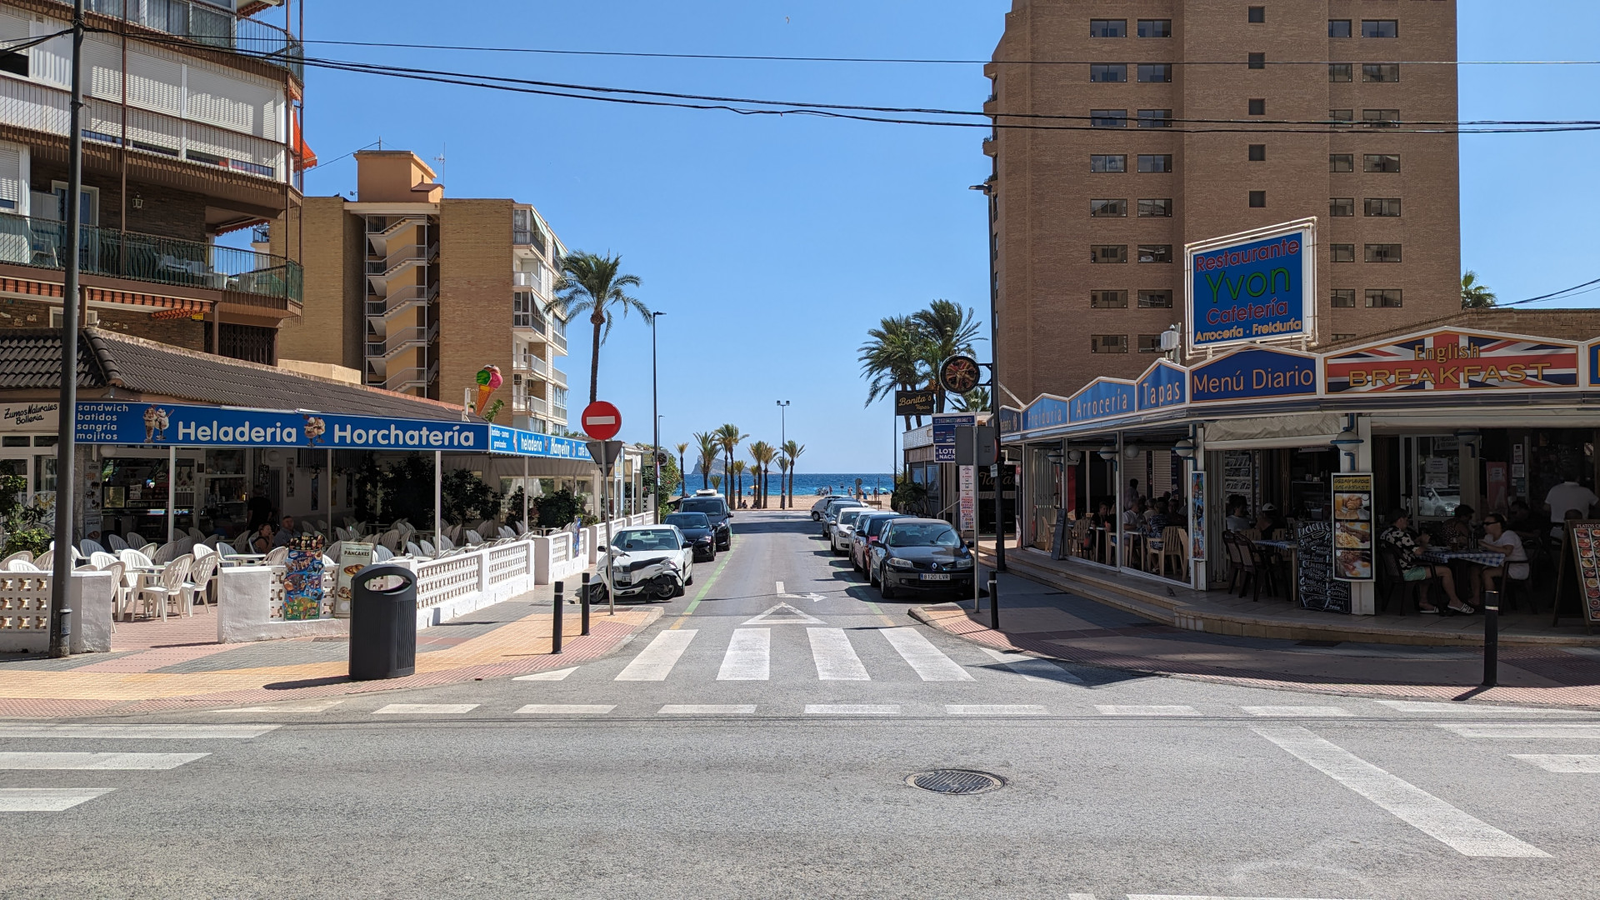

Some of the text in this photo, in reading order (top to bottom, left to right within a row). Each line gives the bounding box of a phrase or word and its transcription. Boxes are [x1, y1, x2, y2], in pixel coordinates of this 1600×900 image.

[1195, 239, 1300, 272] Restaurante
[1205, 267, 1291, 303] Yvon
[1206, 297, 1289, 325] Cafetería
[1194, 317, 1302, 342] Arrocería Freiduría
[1414, 342, 1481, 363] English
[1193, 365, 1314, 394] Menú Diario
[1348, 362, 1552, 387] BREAKFAST
[898, 394, 932, 407] Bonita's
[1075, 388, 1128, 418] Arrocería
[1142, 381, 1181, 408] Tapas
[4, 404, 58, 420] Zumos Naturales
[77, 413, 118, 421] batidos
[78, 404, 129, 412] sandwich
[76, 431, 118, 441] mojitos
[77, 422, 117, 432] sangría
[177, 420, 297, 443] Heladeria
[333, 422, 475, 446] Horchatería
